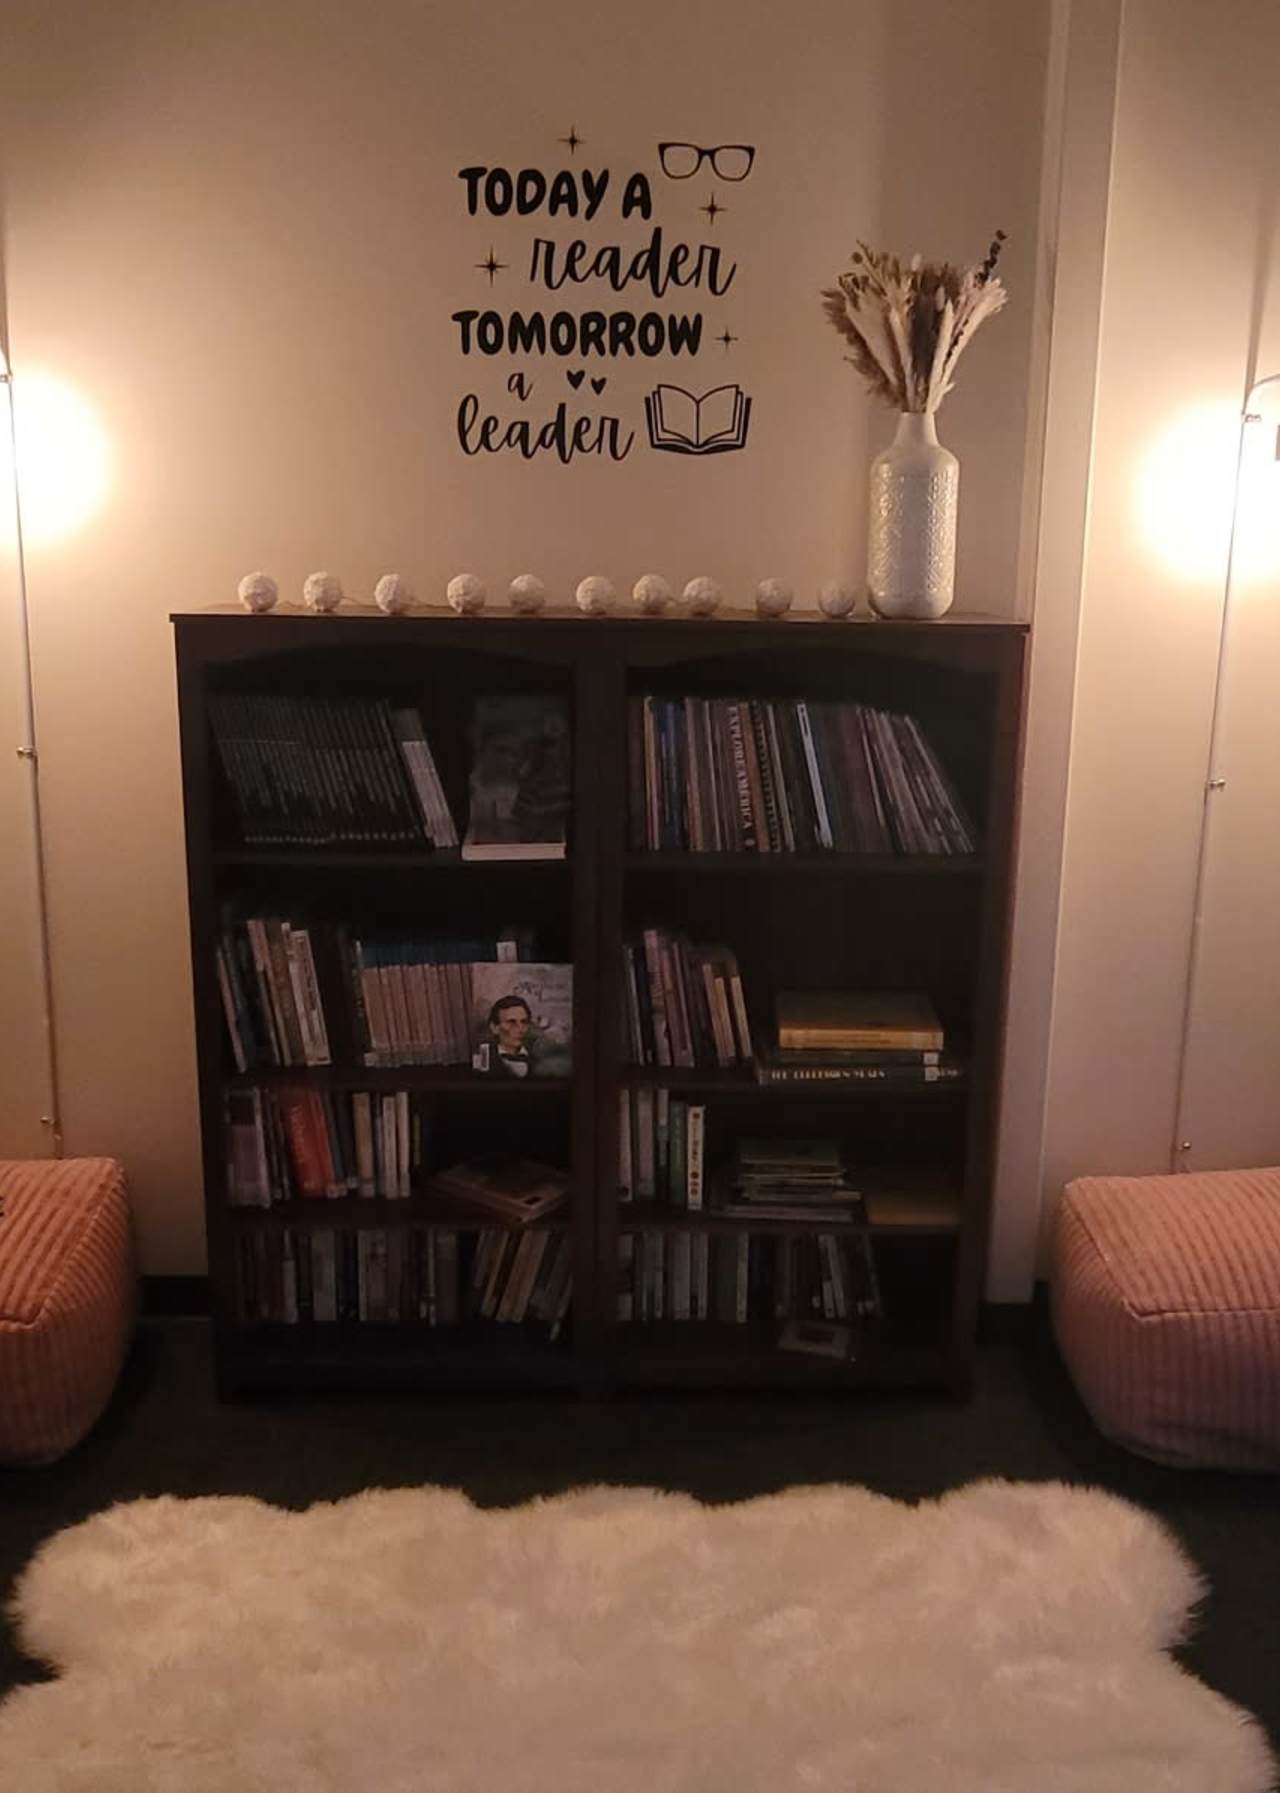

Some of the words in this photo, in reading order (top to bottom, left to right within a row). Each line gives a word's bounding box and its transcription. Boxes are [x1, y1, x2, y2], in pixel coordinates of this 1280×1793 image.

[457, 166, 610, 222] TODAY
[621, 171, 653, 221] A
[529, 226, 738, 299] reader
[451, 309, 704, 358] TOMORROW
[506, 371, 533, 402] a
[457, 393, 635, 465] leader
